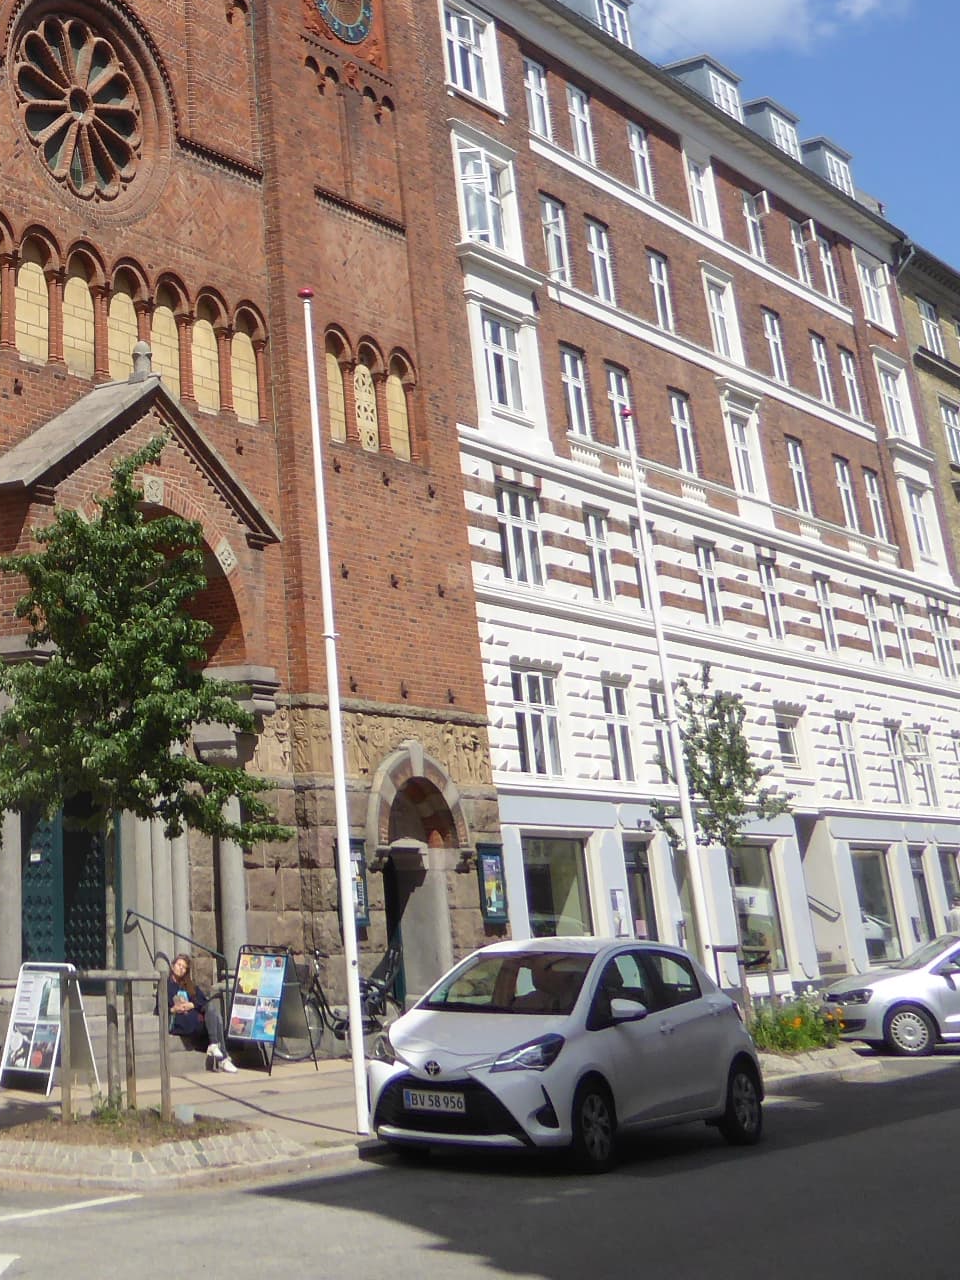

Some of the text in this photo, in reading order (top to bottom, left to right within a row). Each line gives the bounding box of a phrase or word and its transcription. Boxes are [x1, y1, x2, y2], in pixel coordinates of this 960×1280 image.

[411, 1093, 463, 1110] BV 58 956
